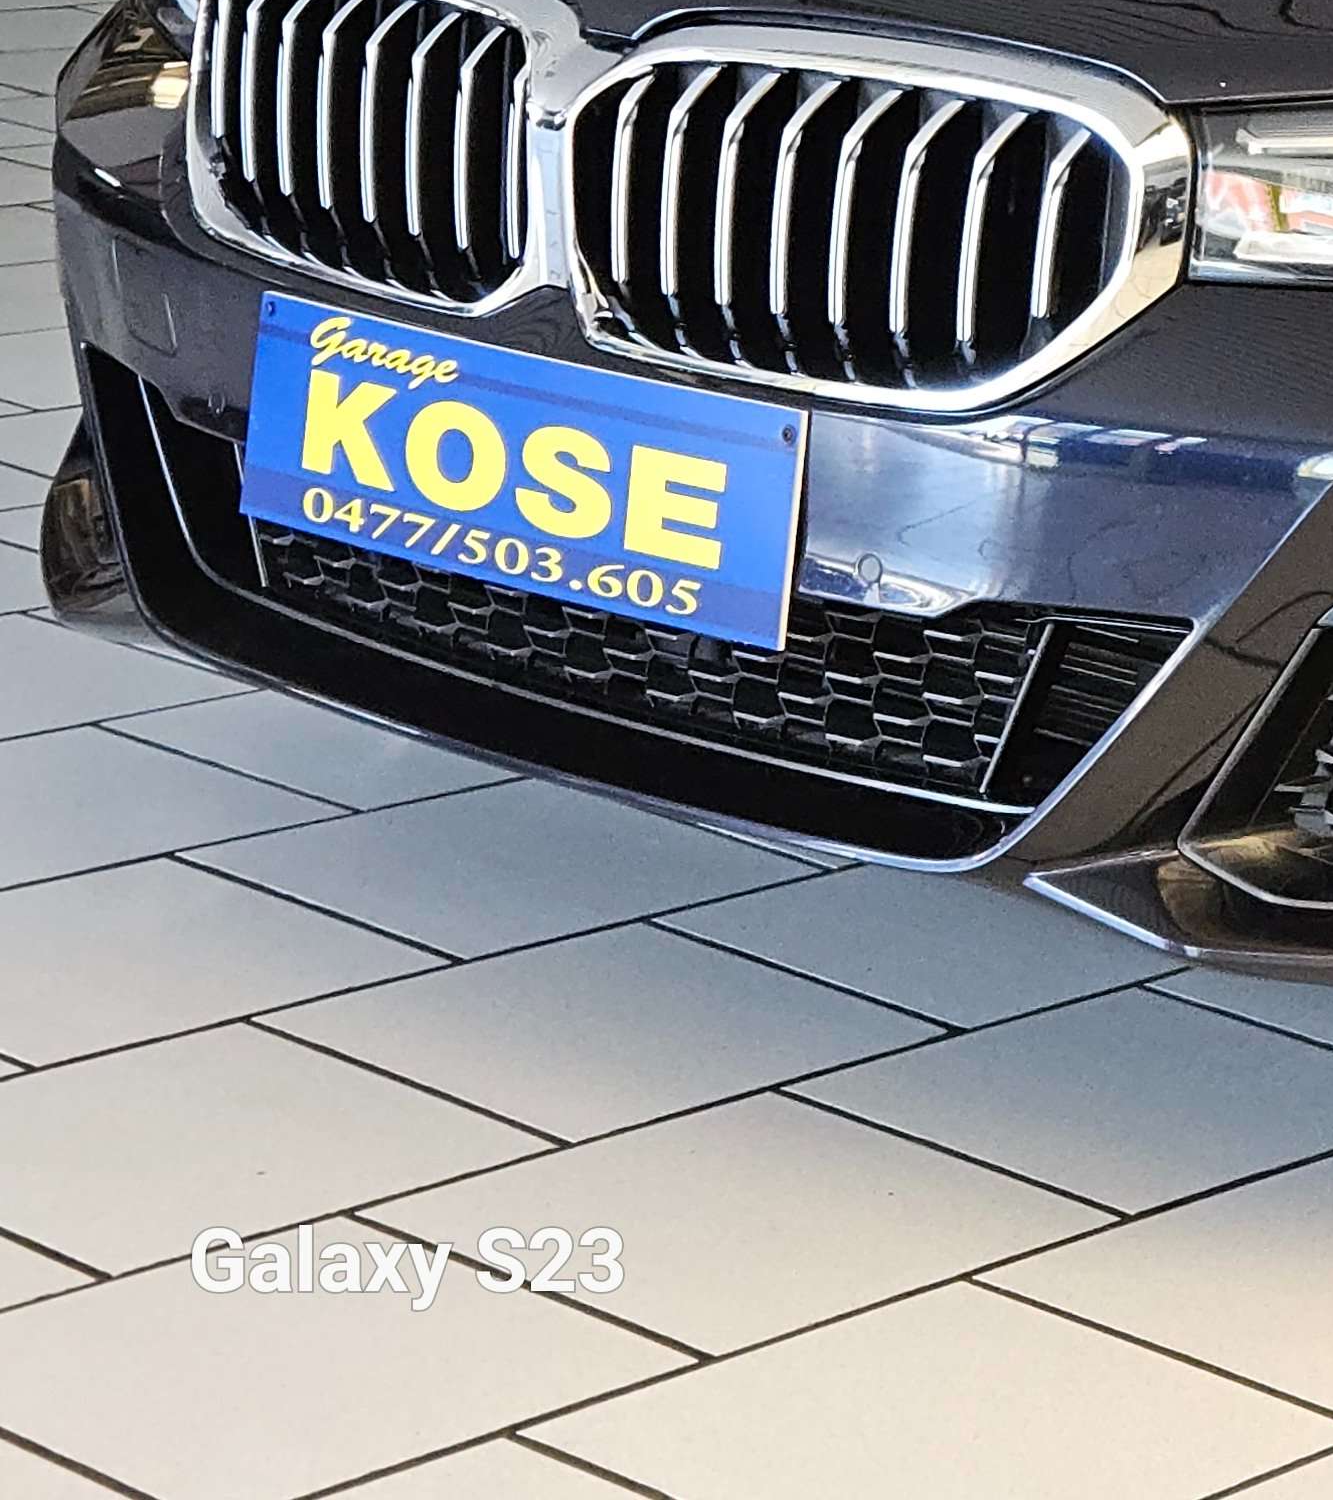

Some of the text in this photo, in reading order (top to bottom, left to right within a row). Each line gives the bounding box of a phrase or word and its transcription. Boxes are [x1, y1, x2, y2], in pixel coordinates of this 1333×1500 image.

[310, 316, 460, 390] Garage
[301, 368, 728, 570] KOSE
[303, 487, 702, 616] 0477/503.605
